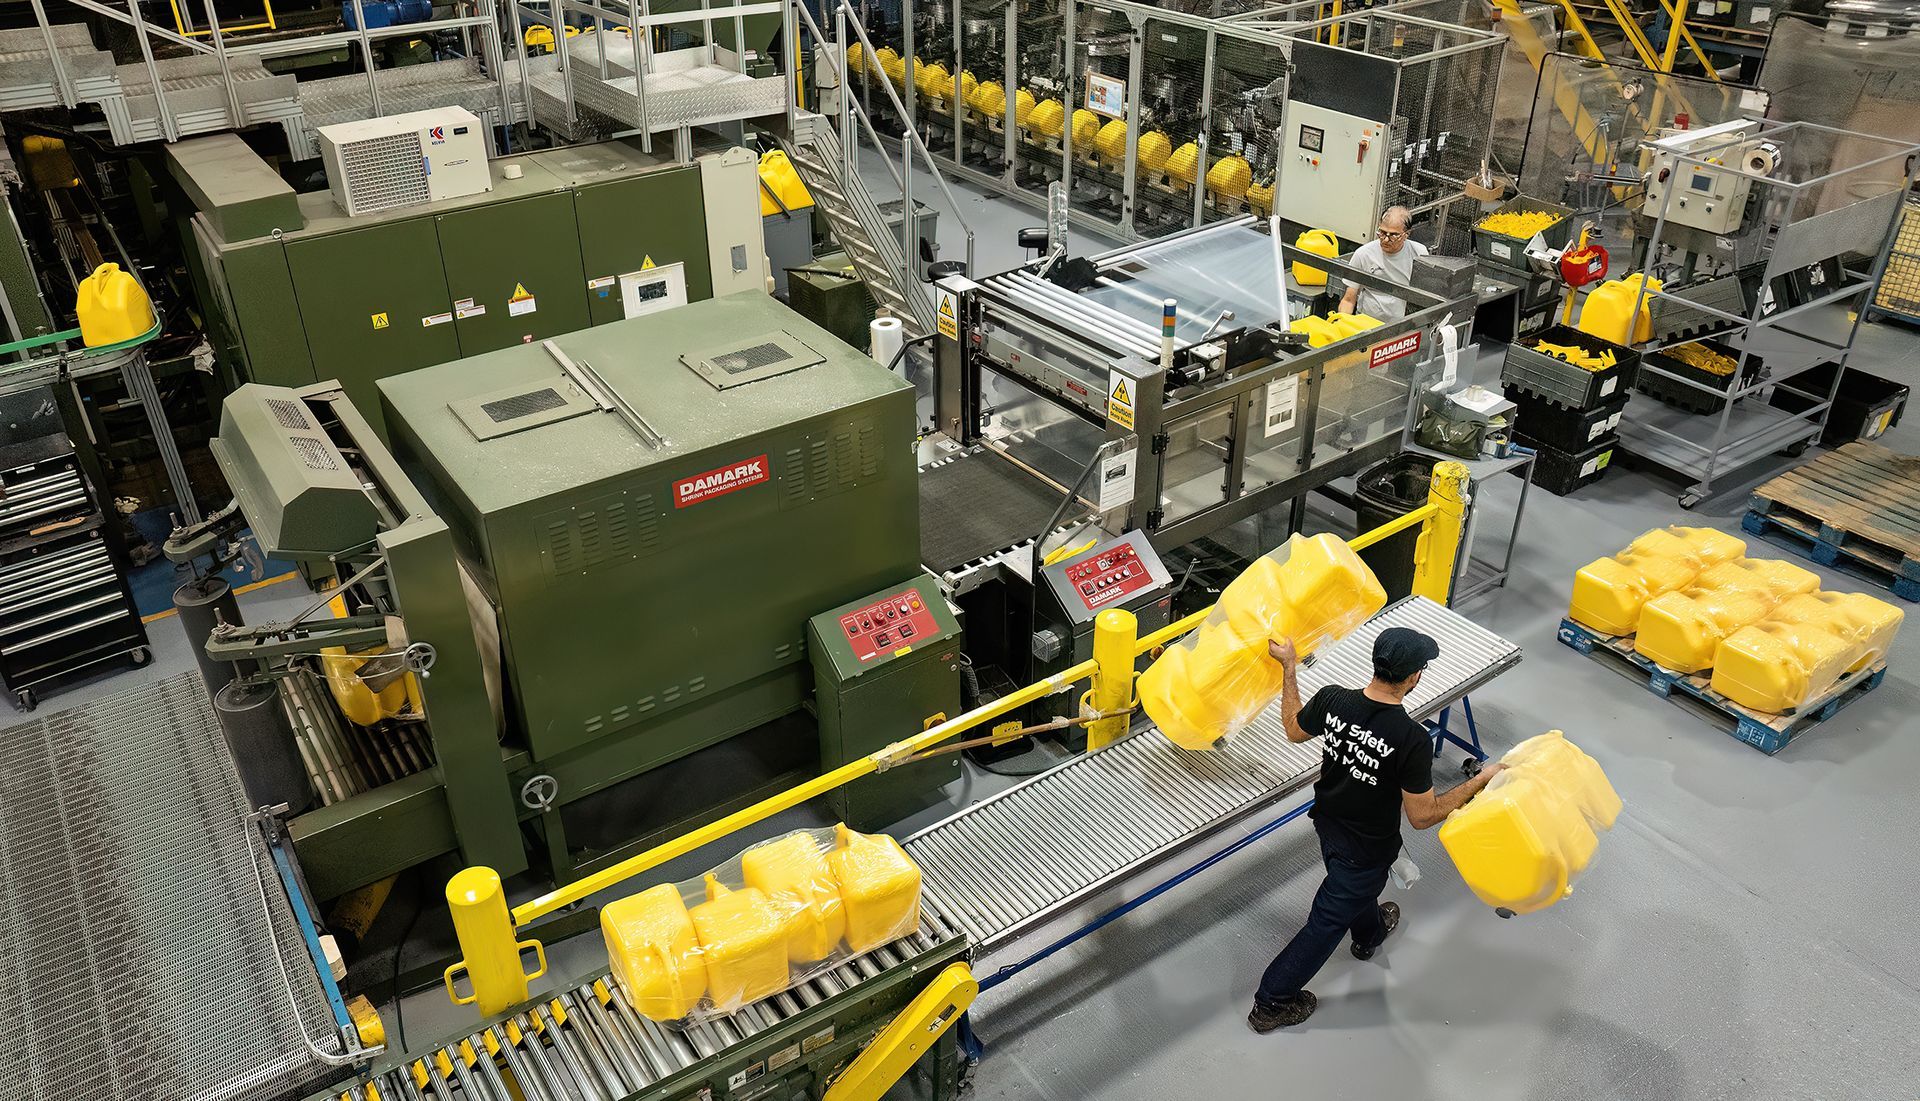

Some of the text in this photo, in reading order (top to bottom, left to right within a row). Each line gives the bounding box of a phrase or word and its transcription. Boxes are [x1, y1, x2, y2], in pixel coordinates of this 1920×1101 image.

[1373, 336, 1418, 359] DAMARK
[1111, 403, 1132, 418] Caution
[680, 461, 761, 496] DAMARK
[681, 473, 764, 503] SHRINK PACKAGING SYSTEMS
[1088, 586, 1122, 605] DAMARK
[1325, 712, 1347, 732] My
